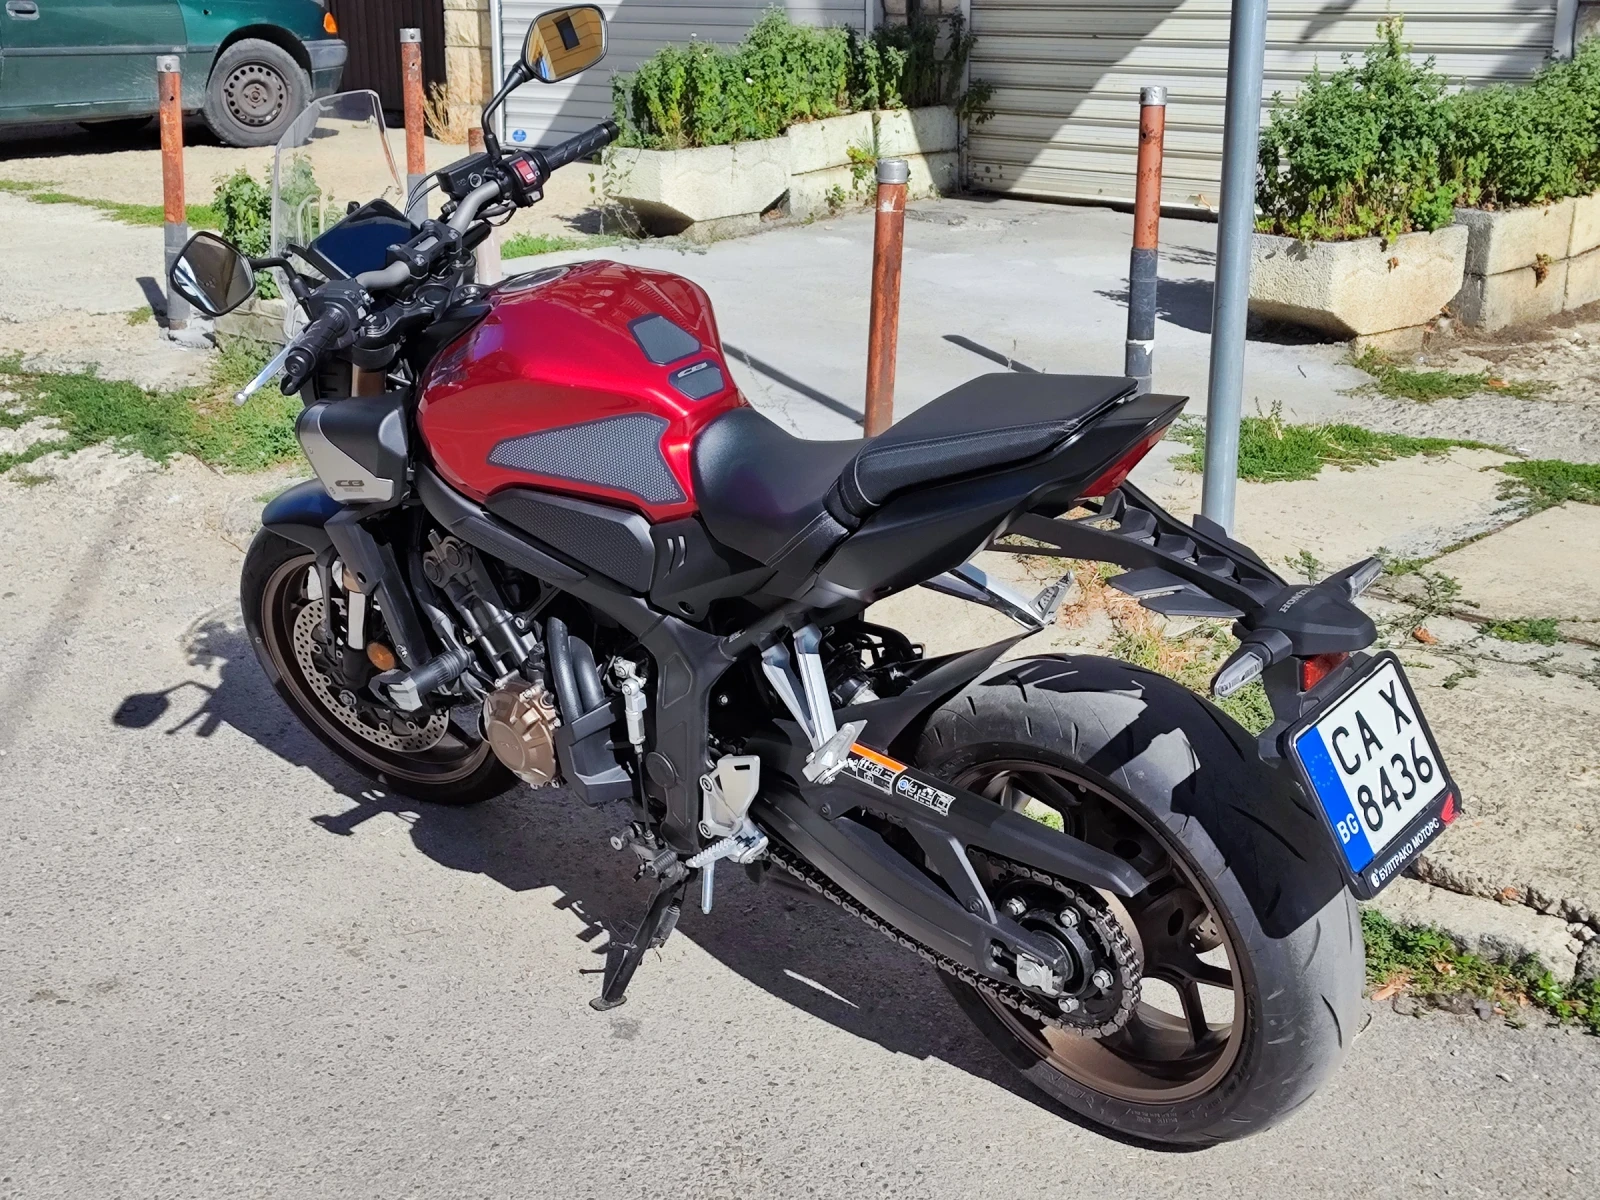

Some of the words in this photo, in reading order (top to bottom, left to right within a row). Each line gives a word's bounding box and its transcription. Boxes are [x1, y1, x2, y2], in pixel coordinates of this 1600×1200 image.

[1279, 587, 1315, 613] HONDA
[1331, 710, 1384, 776] CA
[1378, 679, 1412, 735] X
[1356, 736, 1434, 832] 8436
[1336, 812, 1360, 845] BG
[1378, 842, 1413, 882] БУЛТРАКО
[1411, 817, 1440, 849] МОТОРС
